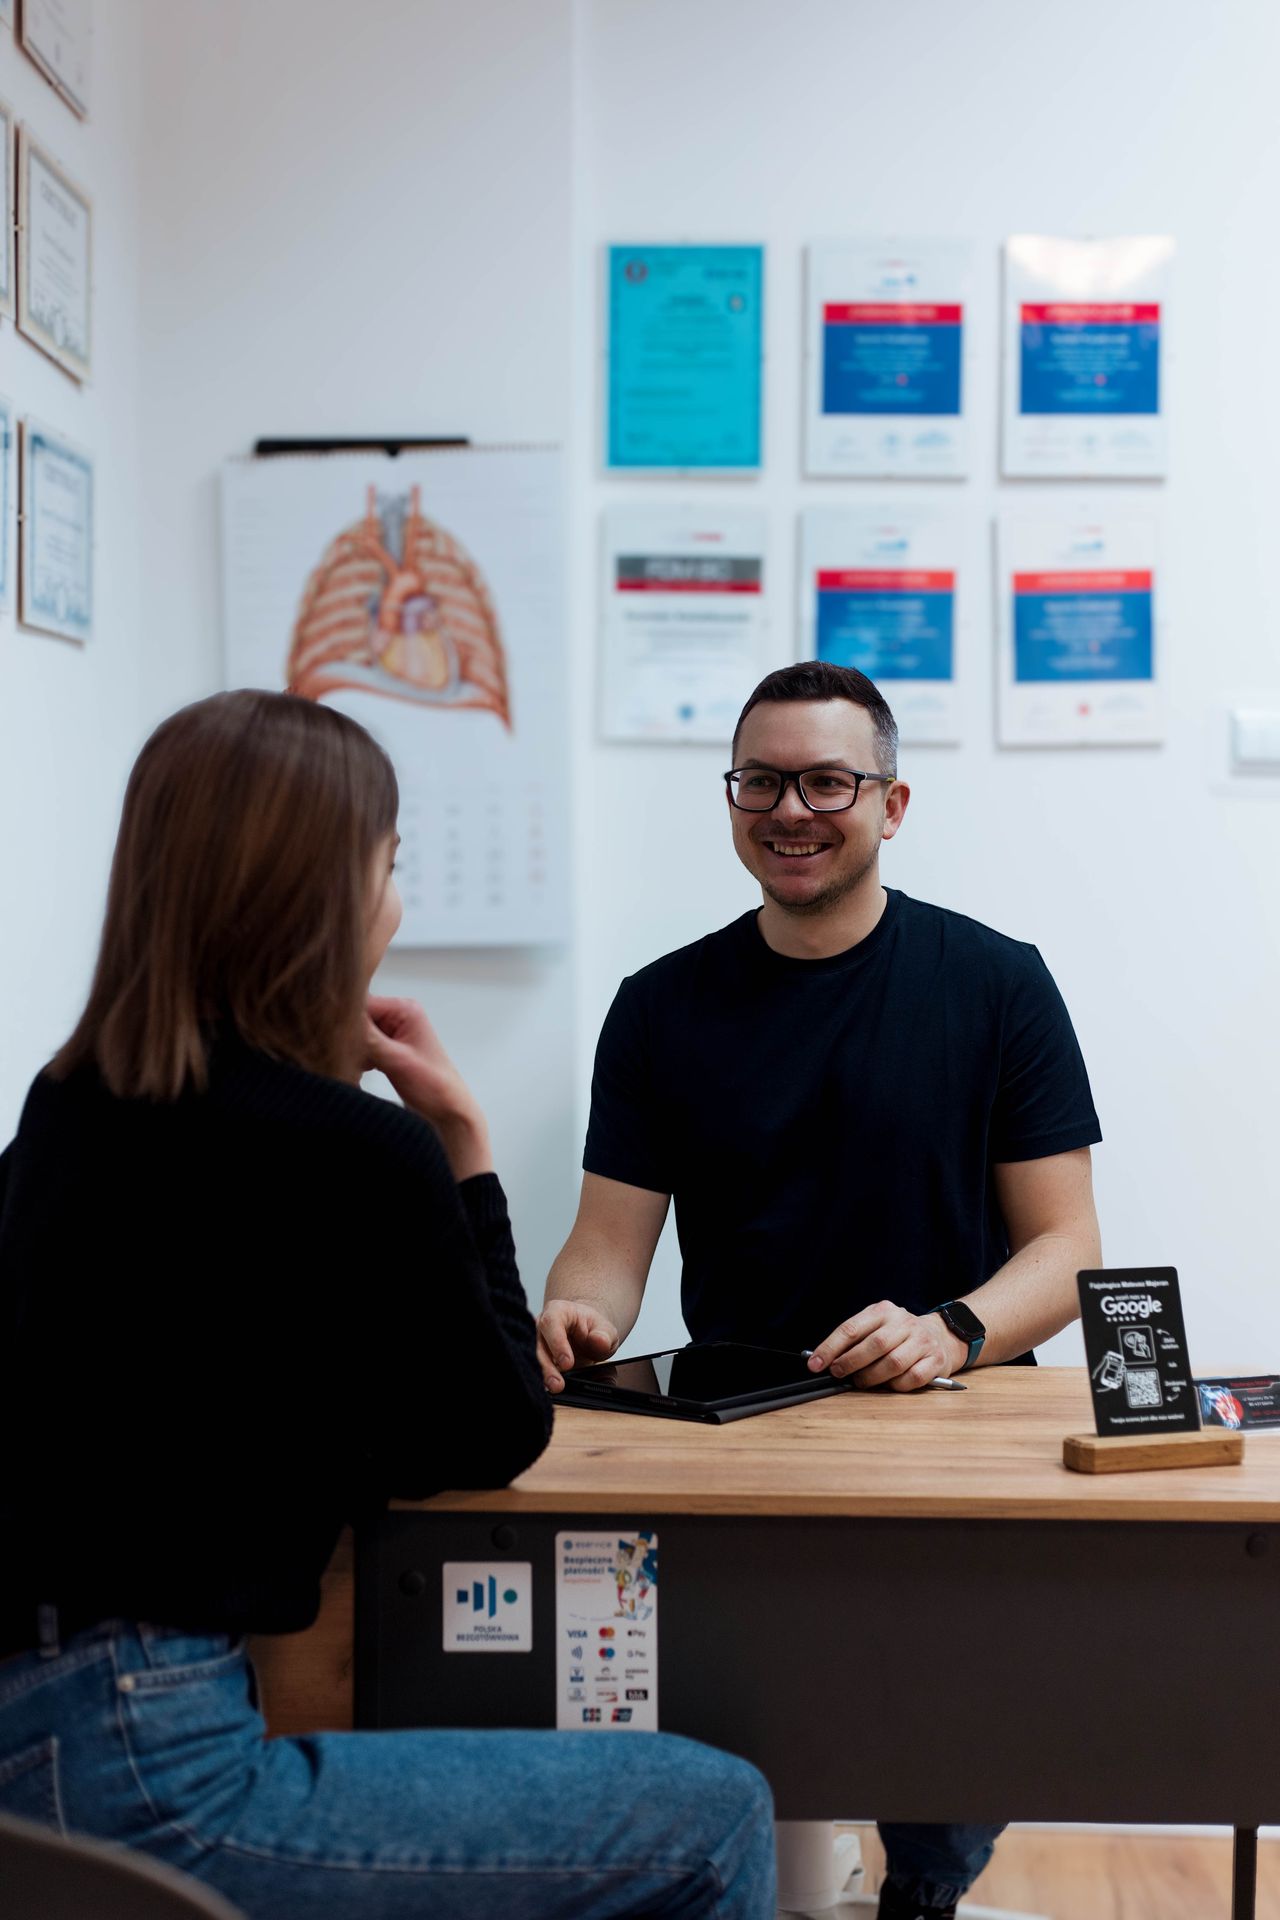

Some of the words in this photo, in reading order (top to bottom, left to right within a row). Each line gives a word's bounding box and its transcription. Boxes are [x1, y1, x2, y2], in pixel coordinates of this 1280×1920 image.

[1100, 1294, 1162, 1318] Google
[473, 1625, 502, 1633] POLSKA
[567, 1629, 588, 1638] VISA
